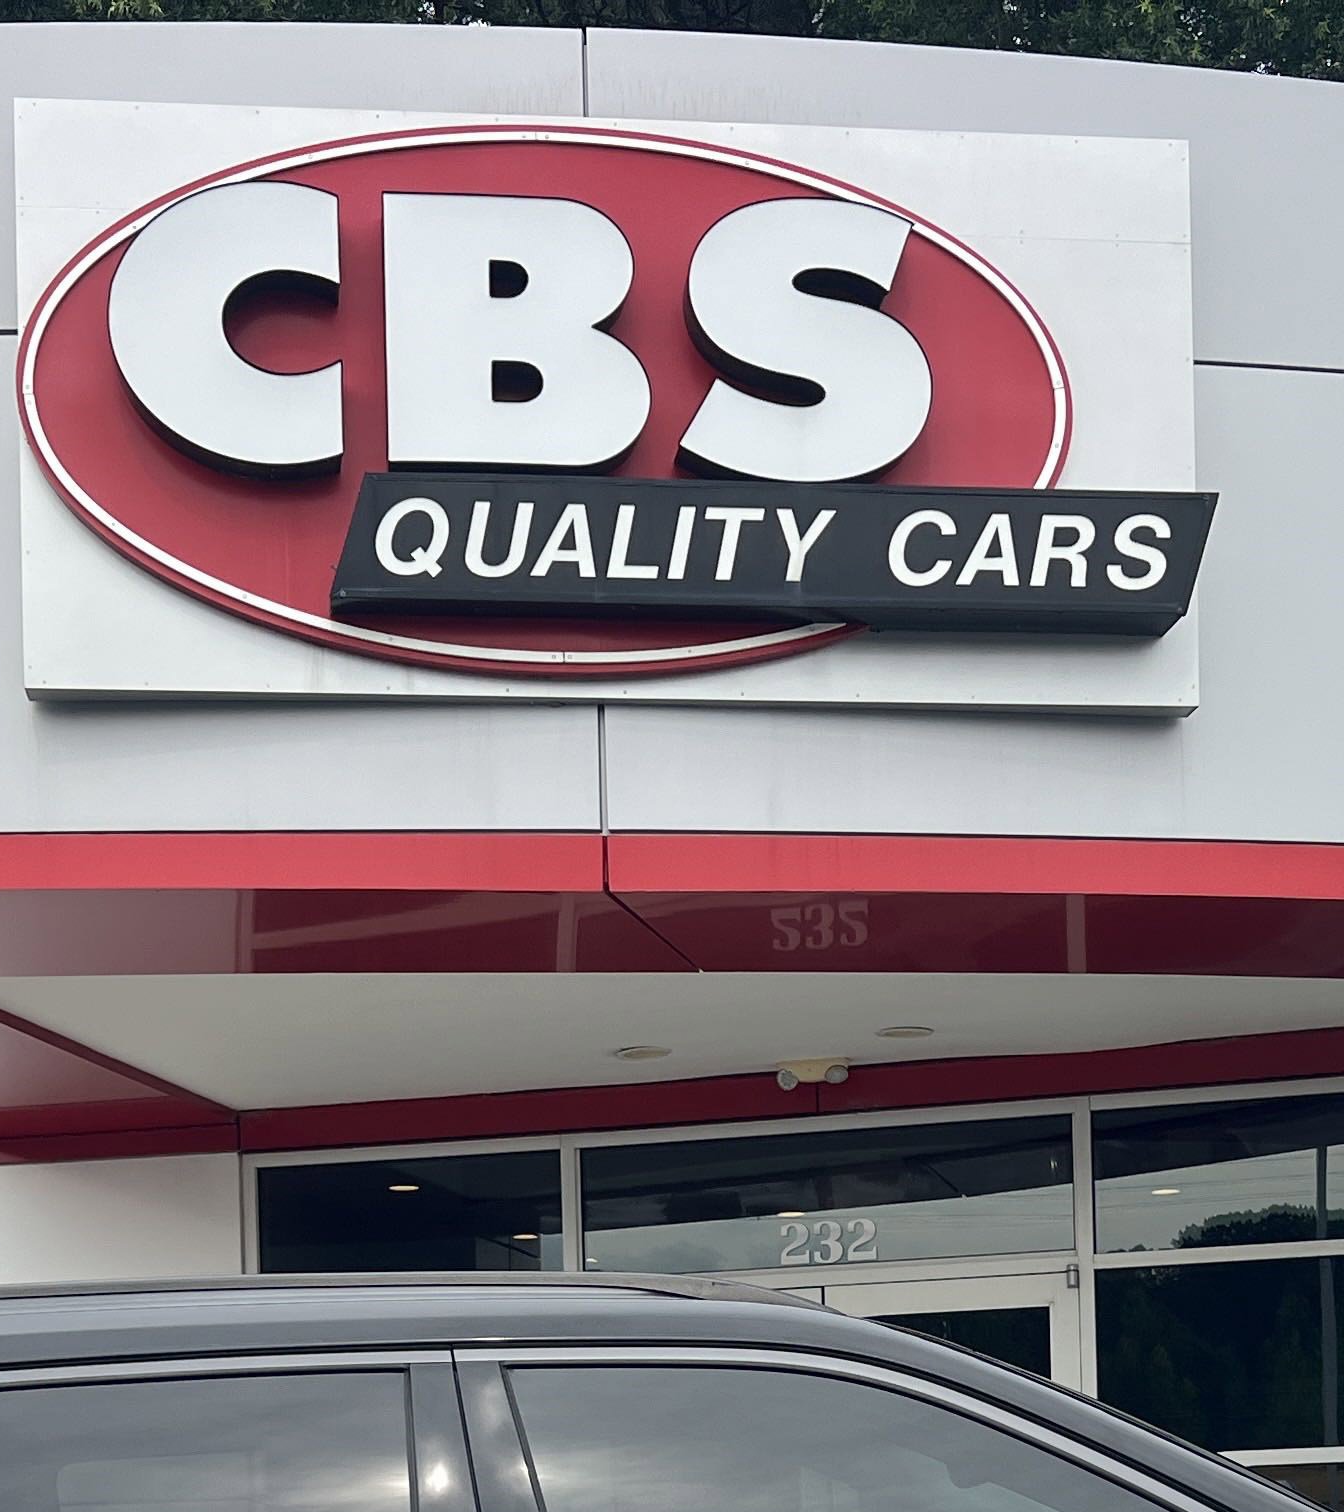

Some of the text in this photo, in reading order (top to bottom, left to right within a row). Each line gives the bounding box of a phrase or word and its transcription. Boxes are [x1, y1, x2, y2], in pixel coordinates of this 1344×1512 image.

[107, 179, 933, 484] CBS
[374, 496, 1173, 592] QUALITY CARS
[780, 1218, 878, 1266] 232
